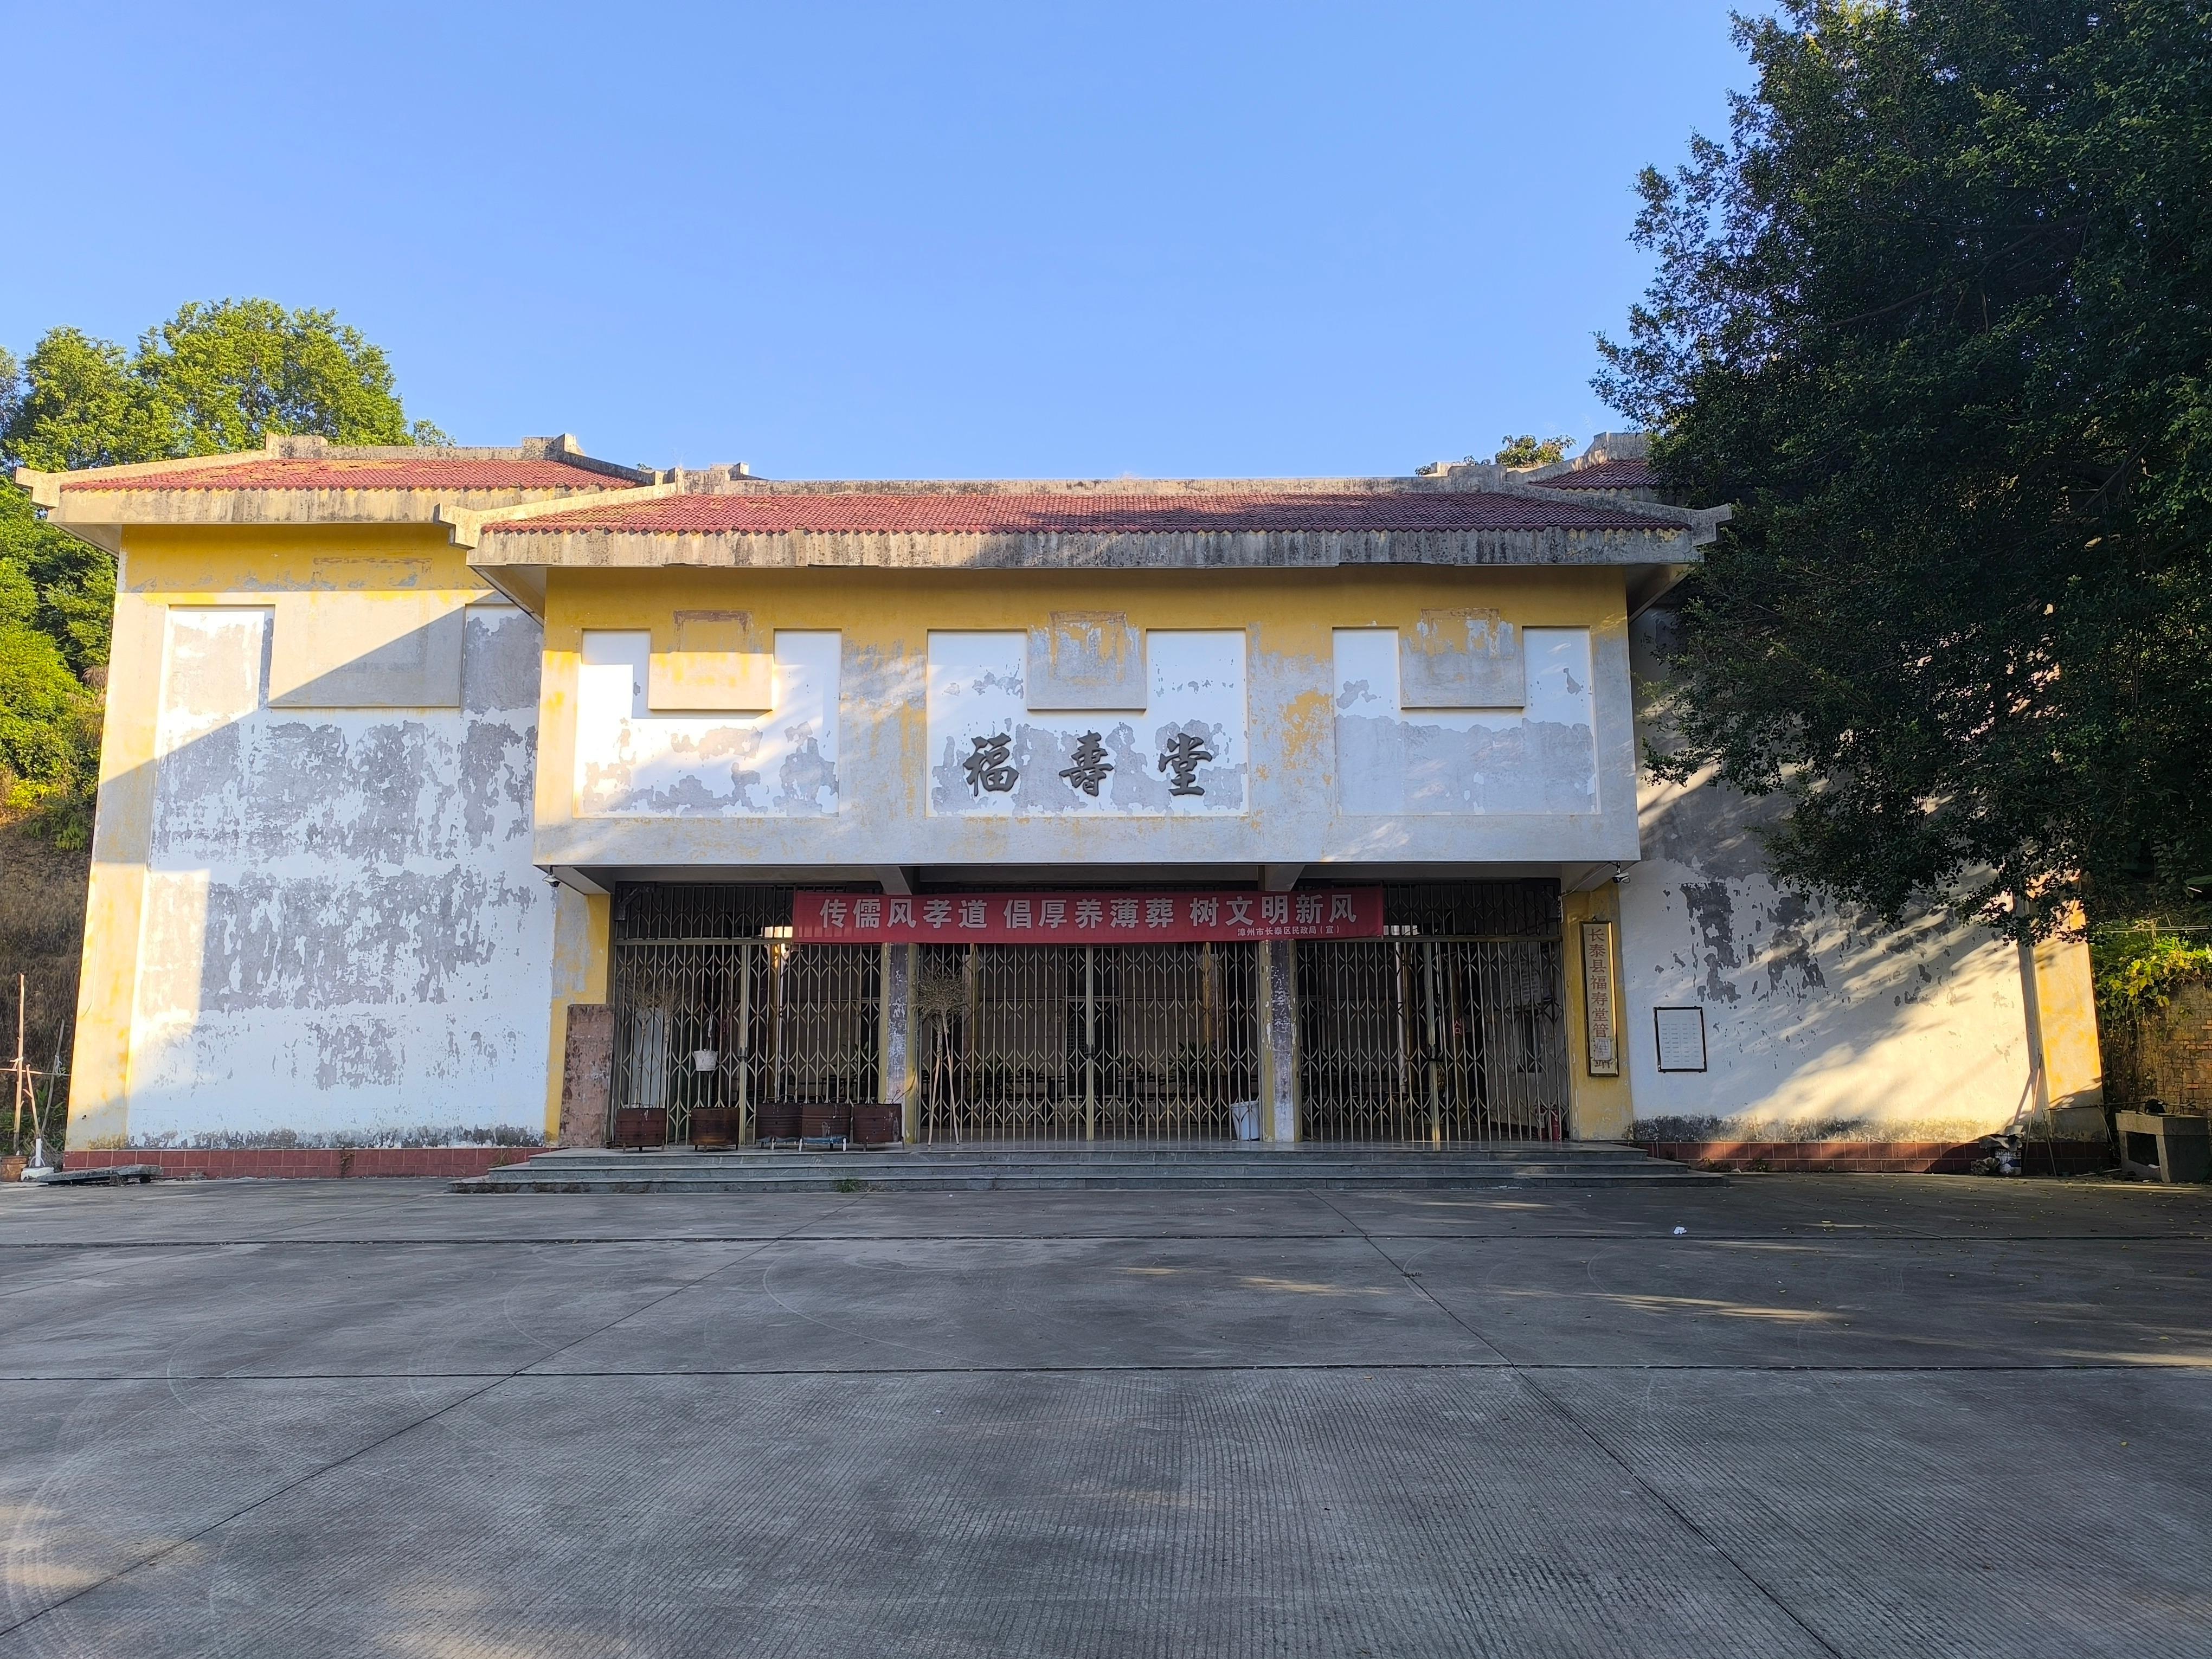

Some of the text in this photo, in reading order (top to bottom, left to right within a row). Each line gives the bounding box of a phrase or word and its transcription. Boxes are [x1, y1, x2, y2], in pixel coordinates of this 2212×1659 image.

[820, 894, 1357, 929] 传儒风孝道 倡厚养薄葬 树文明新风
